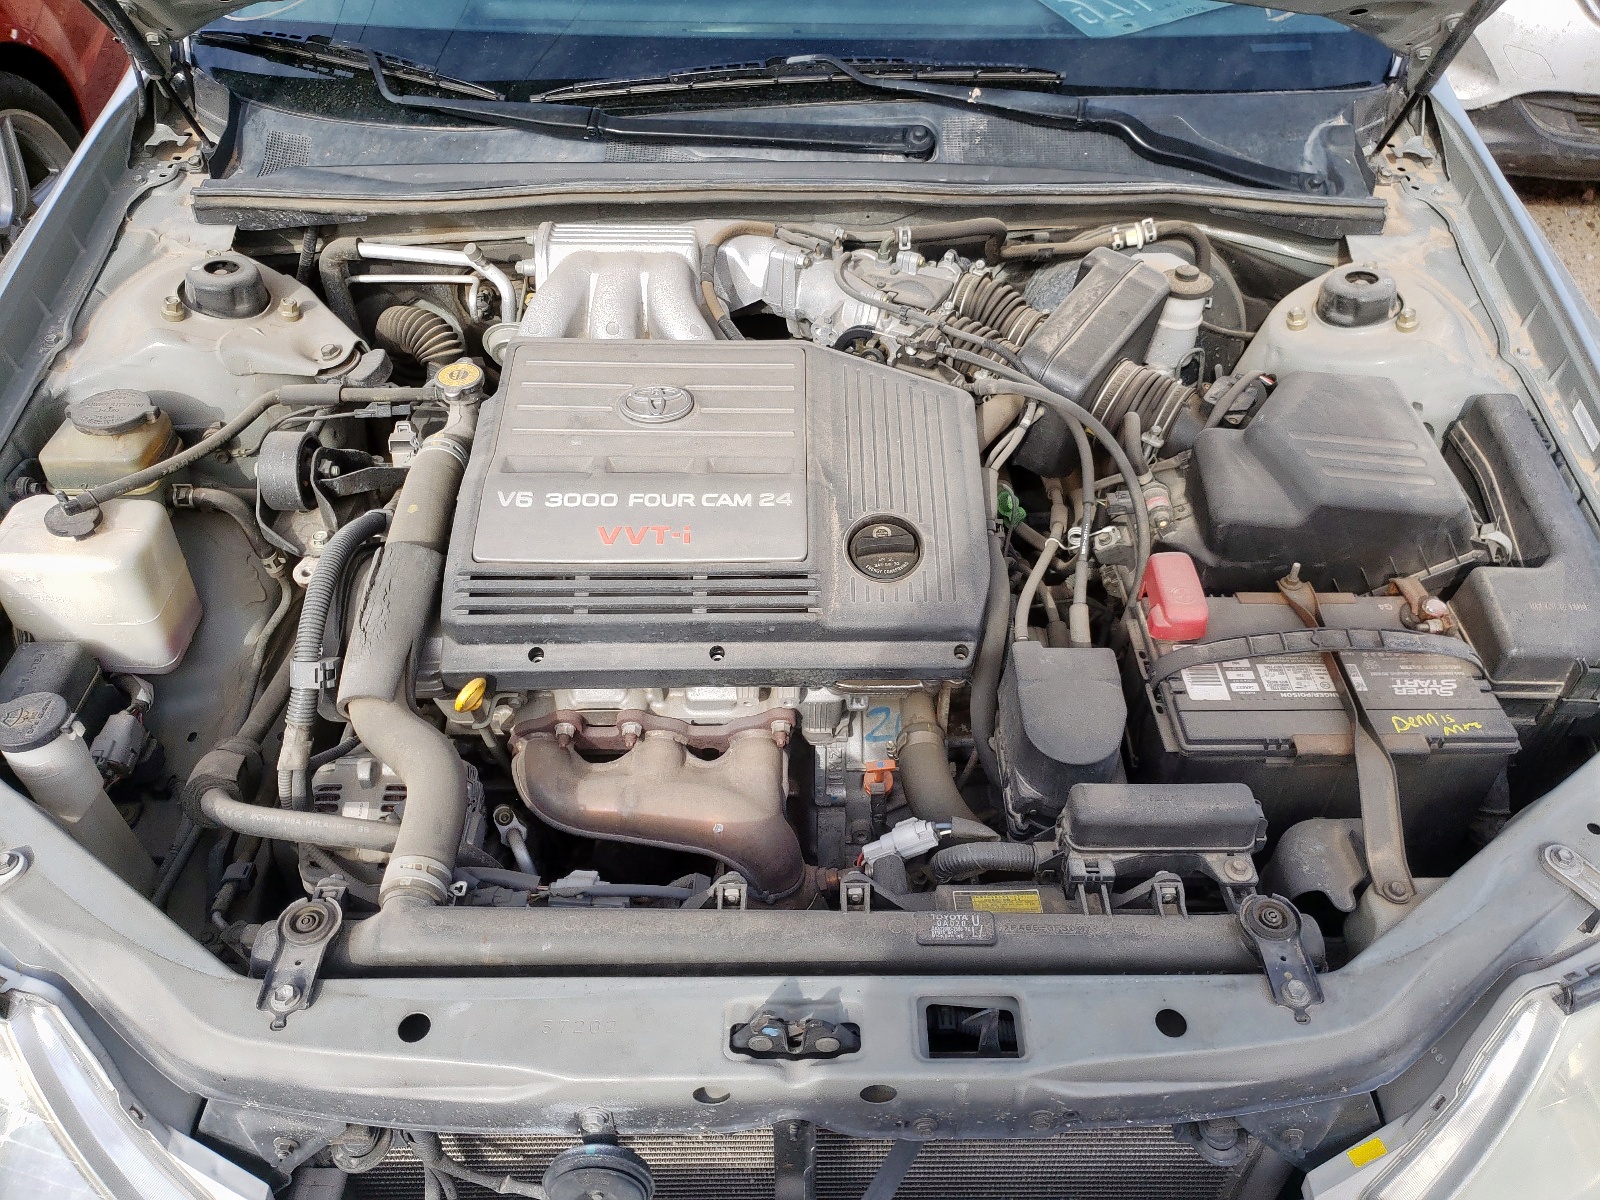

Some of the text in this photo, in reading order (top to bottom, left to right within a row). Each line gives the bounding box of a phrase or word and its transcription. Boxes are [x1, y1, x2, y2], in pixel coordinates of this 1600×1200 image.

[497, 491, 792, 507] V6 3000 FOUR CAM 24
[597, 526, 692, 545] VVT-i
[1391, 679, 1458, 690] START
[1394, 687, 1454, 697] SUPER
